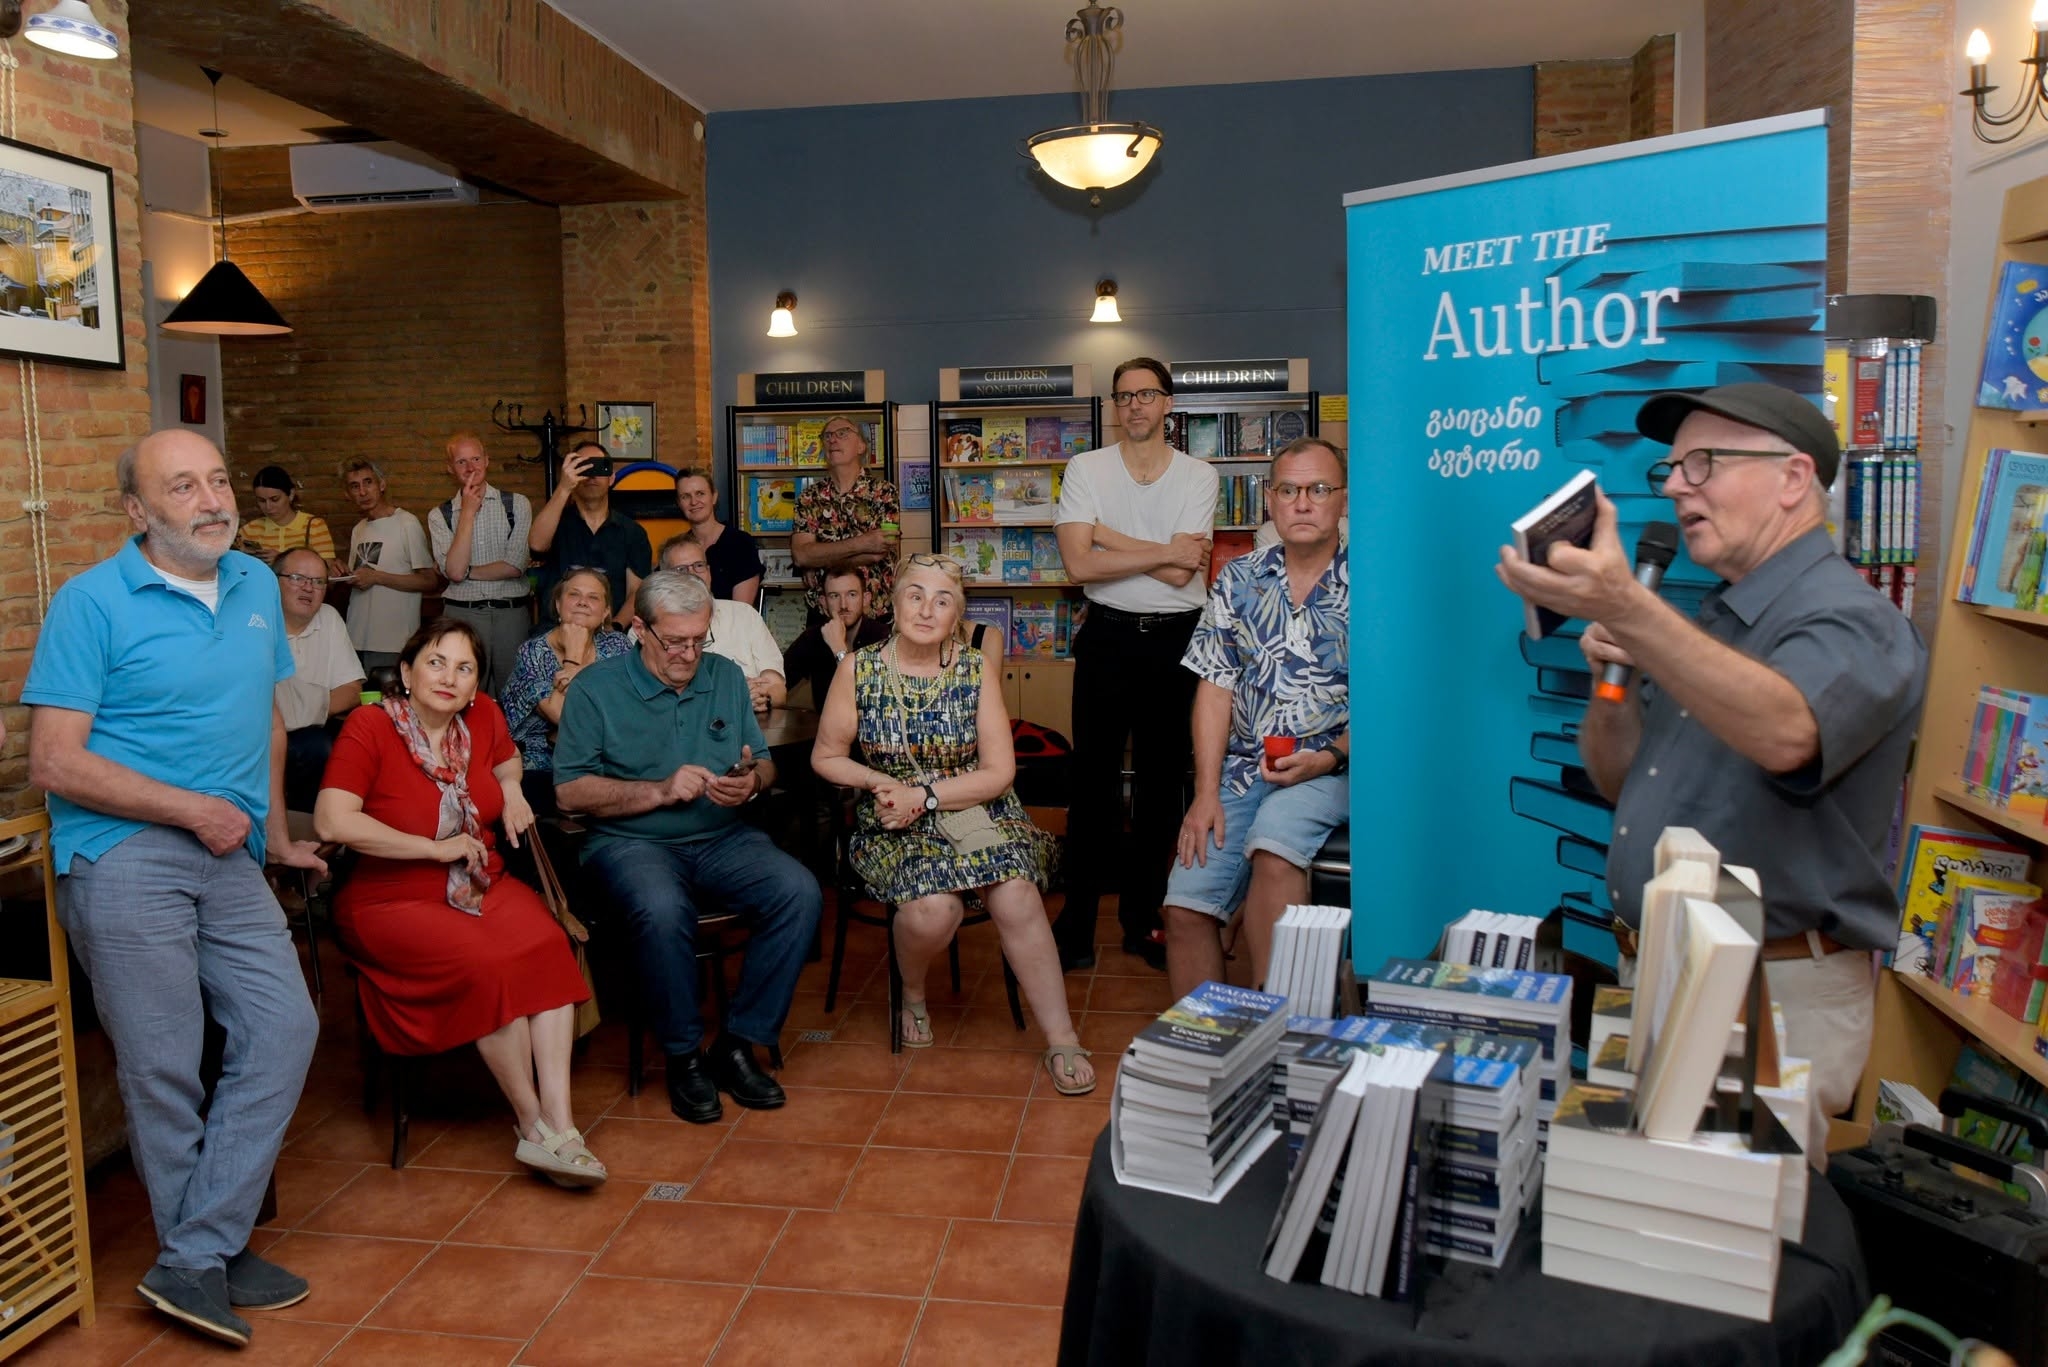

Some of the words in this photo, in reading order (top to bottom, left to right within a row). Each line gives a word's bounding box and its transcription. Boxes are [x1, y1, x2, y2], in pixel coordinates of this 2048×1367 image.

[1421, 235, 1522, 276] MEET
[1531, 223, 1611, 262] THE
[1423, 276, 1680, 361] Author
[984, 369, 1048, 382] CHILDREN
[1182, 368, 1276, 385] CHILDREN
[766, 379, 853, 396] CHILDREN
[975, 383, 1057, 397] NON-FICTION
[1426, 395, 1541, 438] გაიცანი
[1428, 438, 1541, 478] ავტორი
[1171, 1025, 1222, 1043] Georgia
